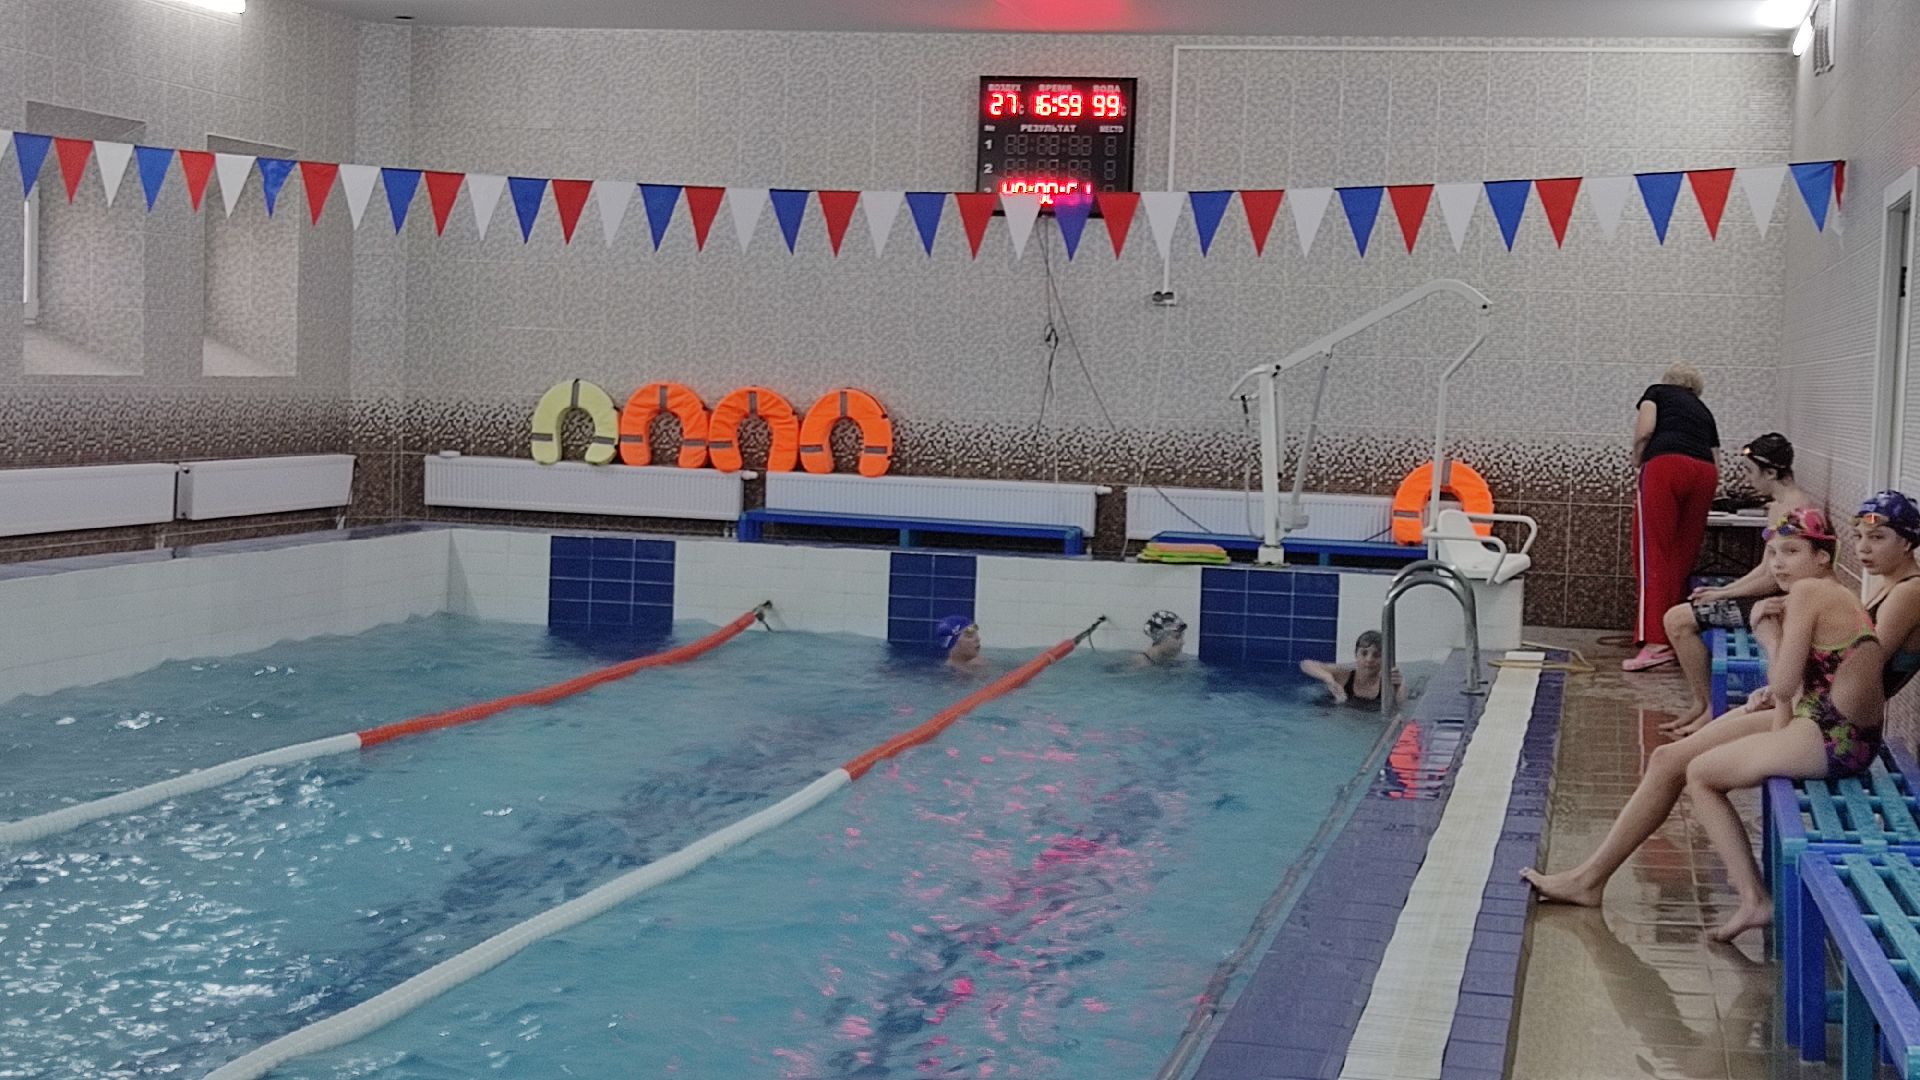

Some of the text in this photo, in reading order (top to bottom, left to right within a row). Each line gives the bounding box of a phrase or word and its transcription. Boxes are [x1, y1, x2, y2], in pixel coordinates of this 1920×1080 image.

[991, 94, 1017, 115] 27
[1035, 95, 1082, 116] 16:59
[1093, 95, 1120, 117] 99
[1020, 124, 1077, 133] РЕЗУЛЬТАТ
[1099, 125, 1124, 133] МЕСТО
[984, 139, 993, 150] 1
[984, 163, 994, 174] 2
